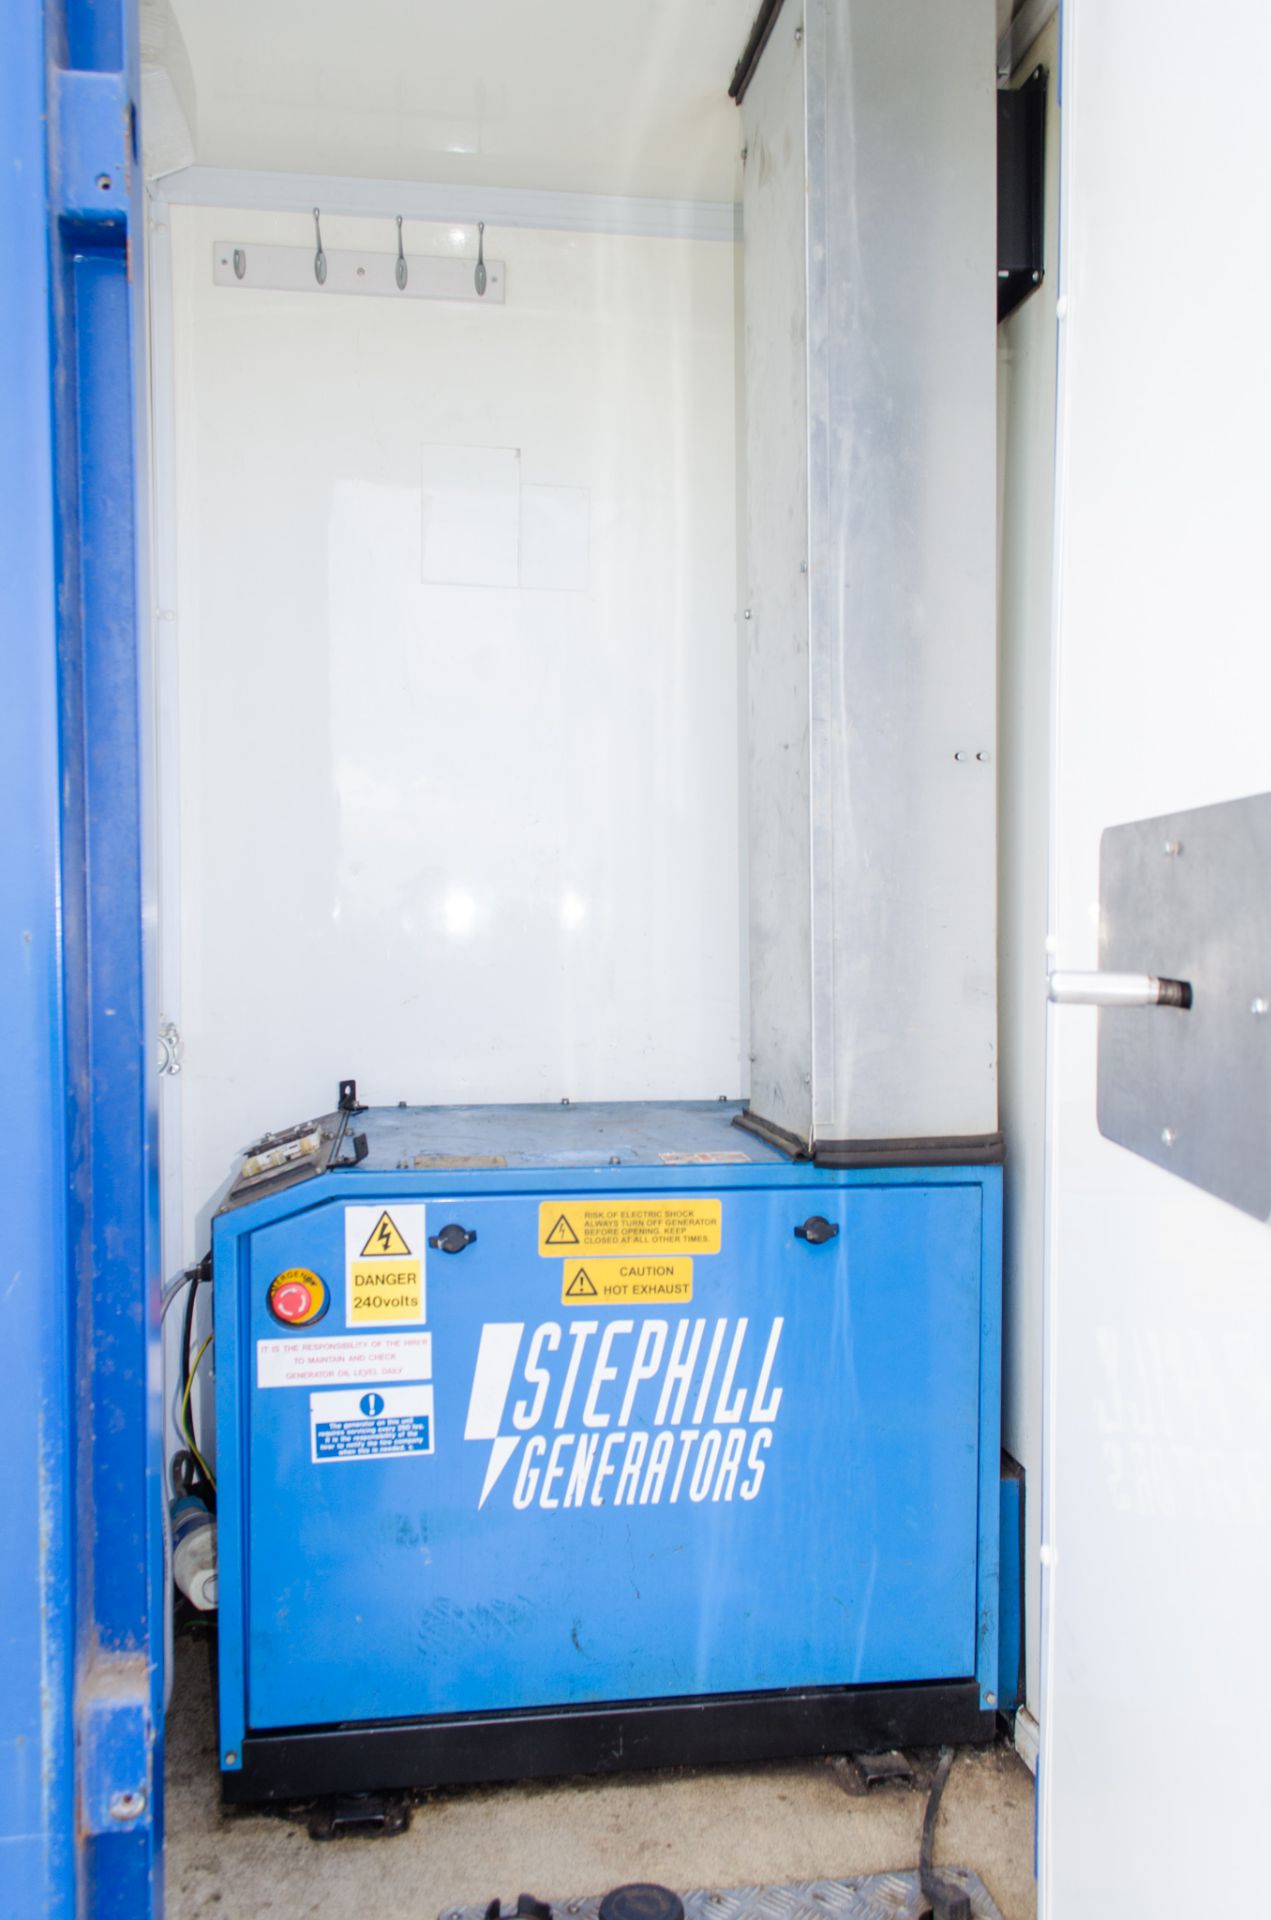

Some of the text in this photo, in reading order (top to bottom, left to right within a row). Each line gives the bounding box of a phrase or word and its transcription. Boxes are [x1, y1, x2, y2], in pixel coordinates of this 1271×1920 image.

[621, 1236, 632, 1244] AT
[620, 1266, 674, 1276] CAUTION
[355, 1272, 417, 1287] DANGER
[604, 1284, 689, 1295] HOT EXHAUST
[354, 1295, 418, 1309] 240volts
[284, 1344, 298, 1352] THE
[302, 1341, 367, 1351] RESPONSIBILITY
[308, 1356, 344, 1364] MAINTAIN
[368, 1353, 396, 1361] CHECK
[286, 1371, 334, 1379] GENERATOR
[512, 1316, 784, 1430] STEPHILL
[512, 1427, 773, 1510] GENERATORS
